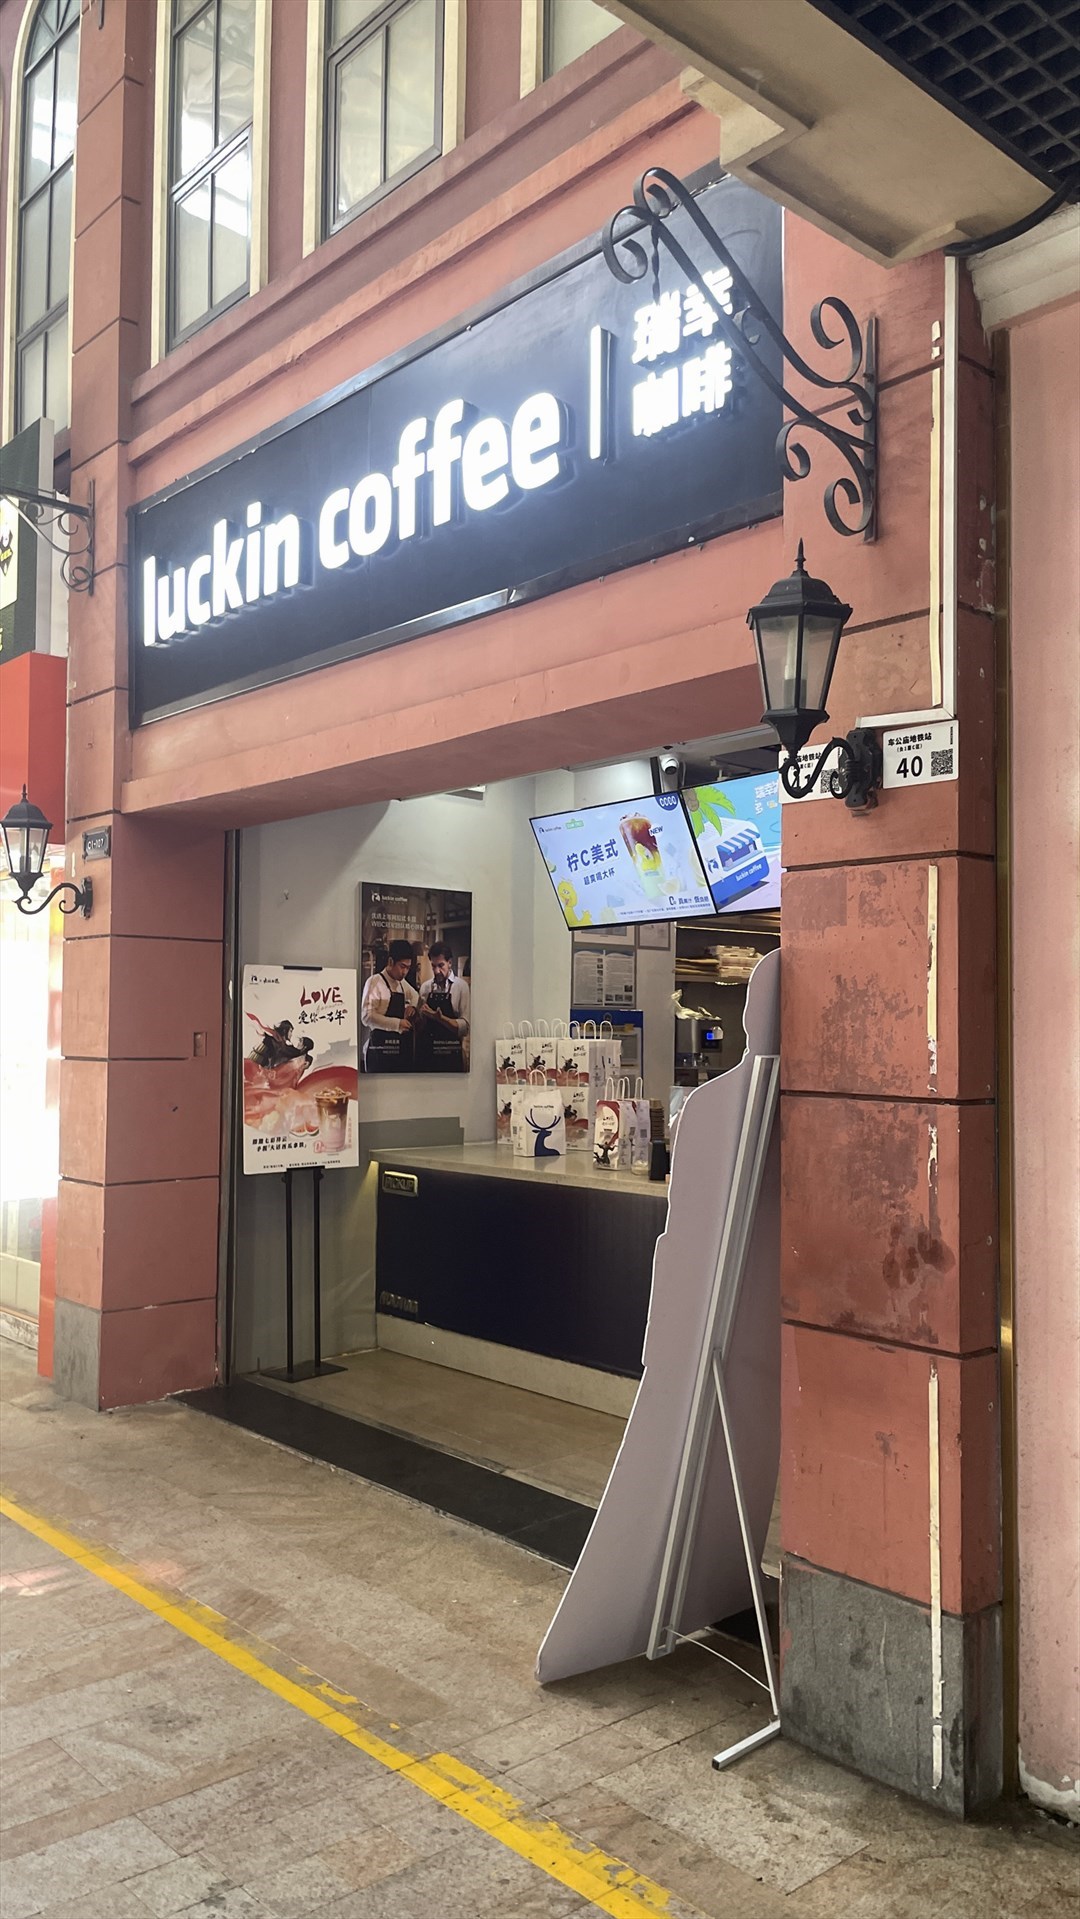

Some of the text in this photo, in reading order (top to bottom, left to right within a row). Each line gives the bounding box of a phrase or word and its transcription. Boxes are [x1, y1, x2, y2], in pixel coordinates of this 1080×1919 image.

[632, 341, 733, 437] 咖啡
[143, 392, 560, 647] luckin coffee
[888, 732, 932, 746] 车公庙地铁站
[896, 755, 923, 778] 40
[650, 826, 663, 835] NEW
[566, 838, 619, 873] 柠C美式
